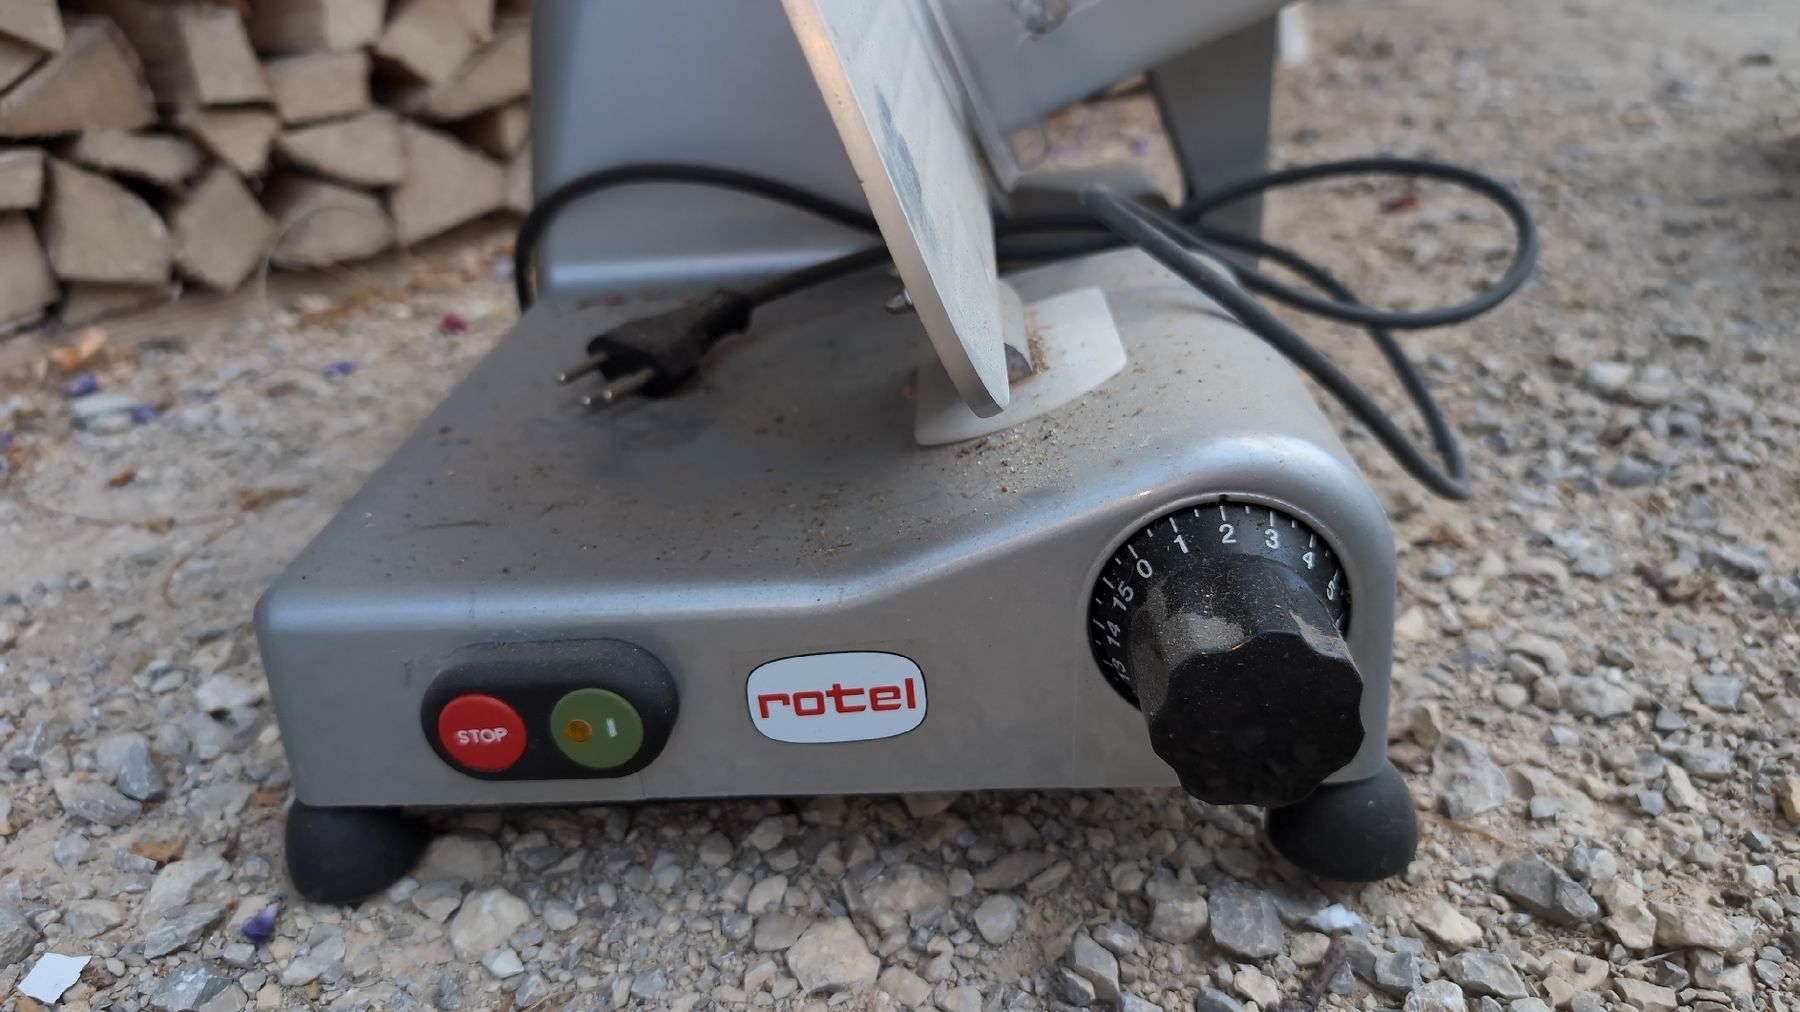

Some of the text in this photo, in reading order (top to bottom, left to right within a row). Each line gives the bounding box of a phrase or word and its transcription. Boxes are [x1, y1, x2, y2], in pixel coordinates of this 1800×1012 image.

[1174, 534, 1189, 554] 1
[1219, 524, 1236, 544] 2
[1265, 529, 1280, 549] 3
[1136, 559, 1152, 578] 0
[1302, 552, 1315, 570] 4
[1112, 581, 1134, 611] 15
[1107, 621, 1121, 646] 14
[758, 678, 916, 718] rotel
[456, 727, 508, 745] STOP
